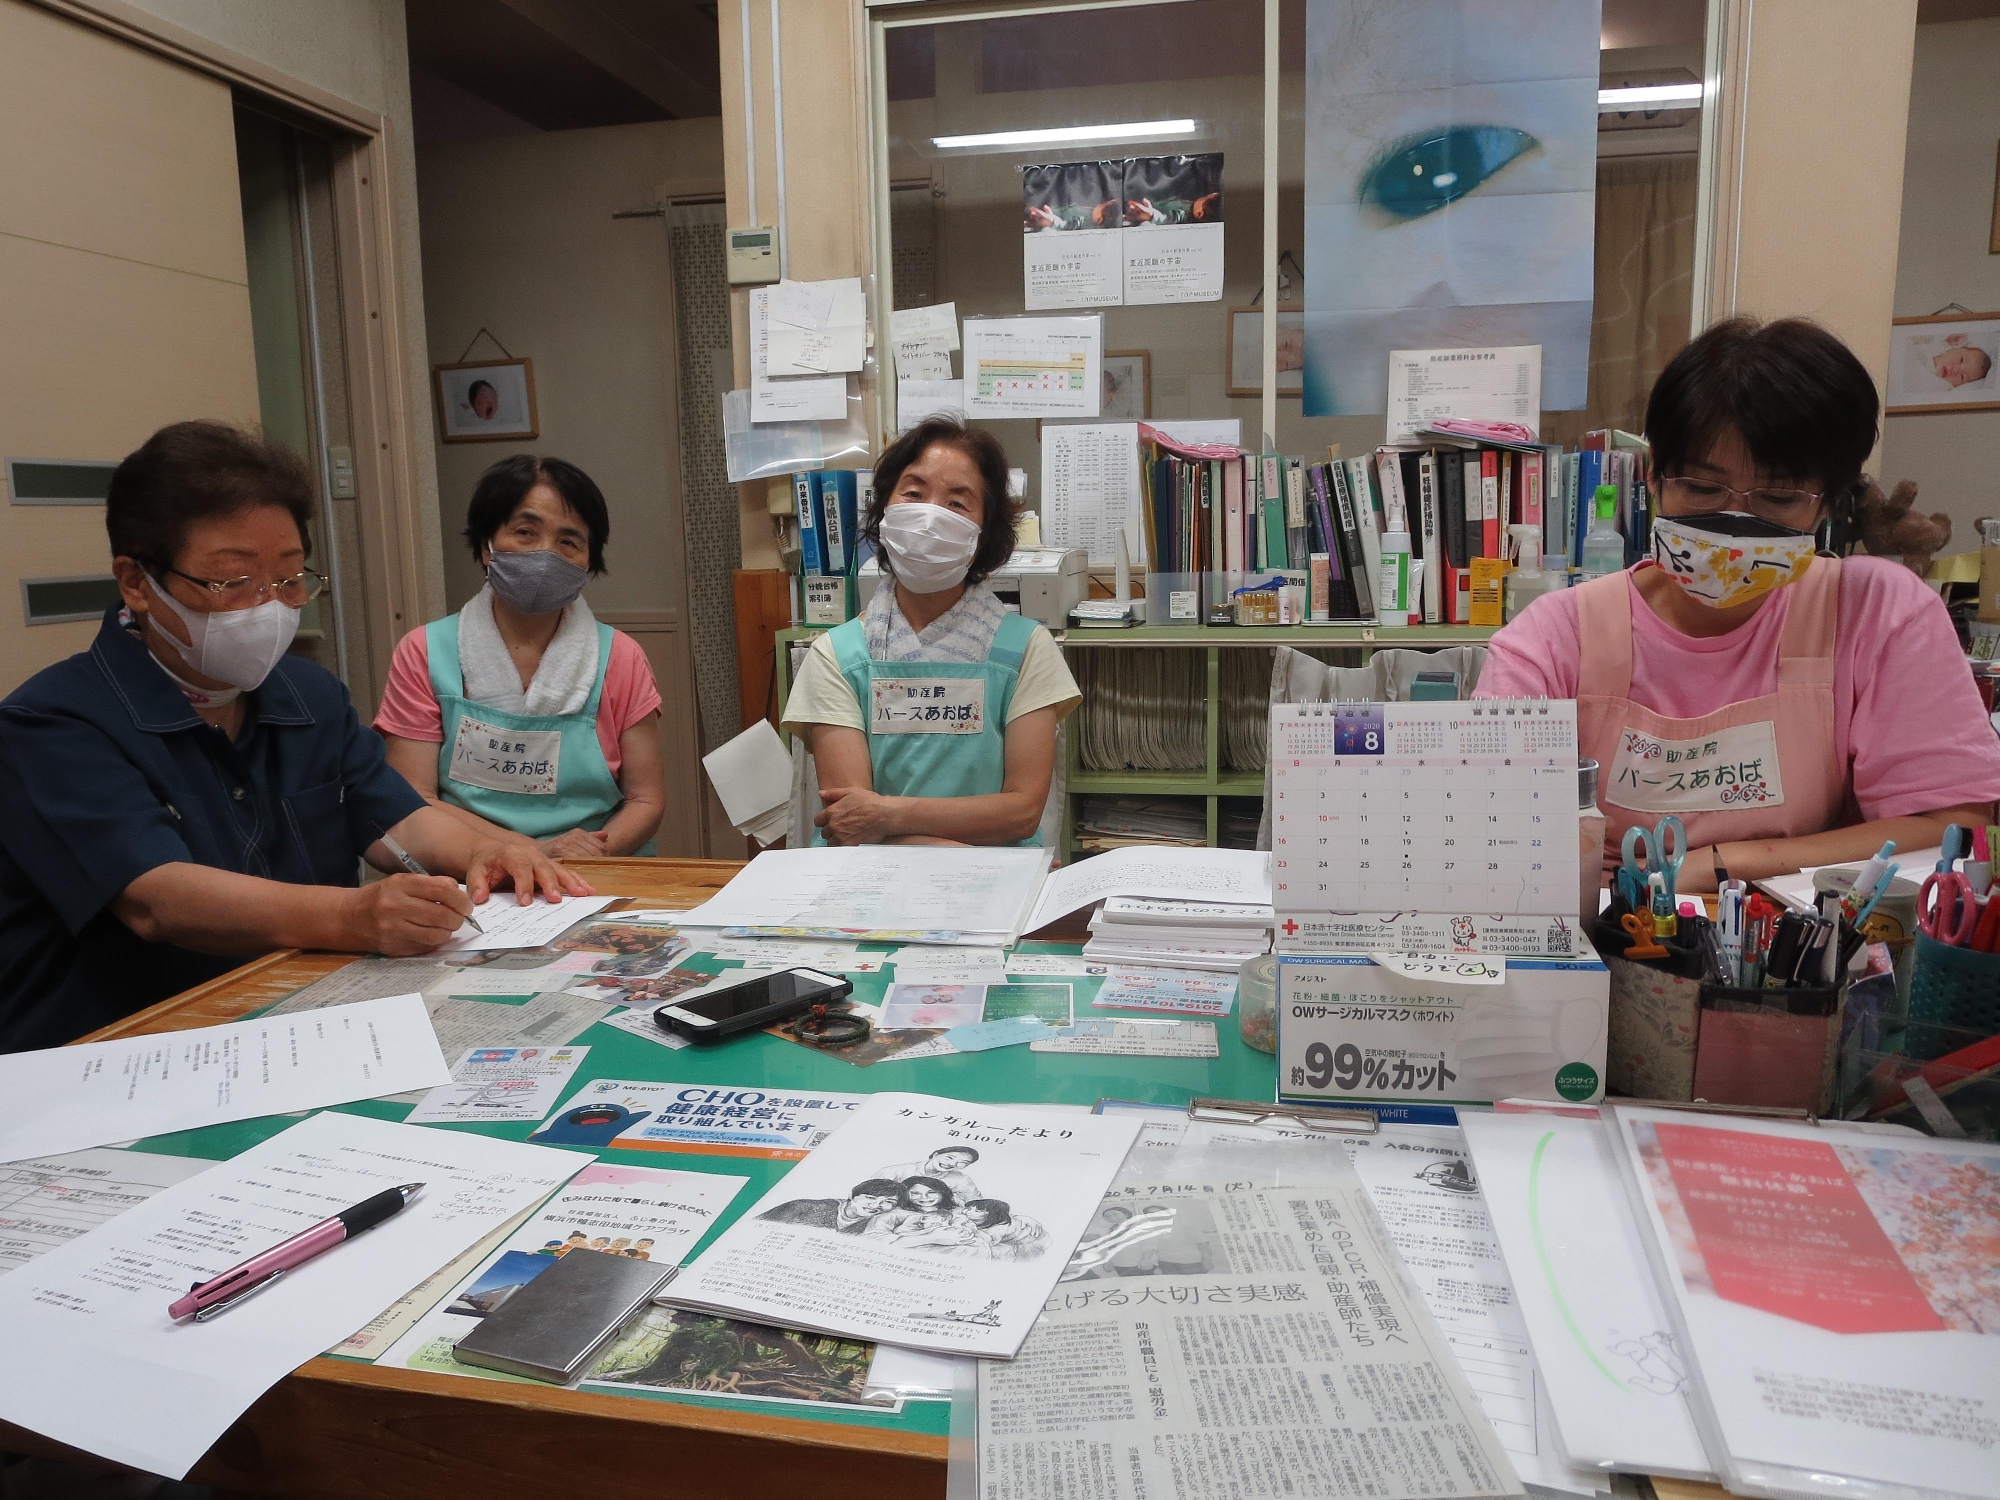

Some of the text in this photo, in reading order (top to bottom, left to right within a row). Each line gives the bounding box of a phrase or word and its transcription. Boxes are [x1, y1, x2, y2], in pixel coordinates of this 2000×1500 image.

[825, 495, 840, 545] 分娩台帳
[907, 686, 946, 698] 助産院
[878, 703, 973, 721] バースあおば
[1388, 722, 1394, 731] 9
[1449, 721, 1458, 730] 10
[1513, 721, 1521, 729] 11
[488, 739, 526, 754] 助産院
[1364, 731, 1379, 751] 8
[1666, 741, 1718, 764] 助産院
[458, 749, 550, 776] バースあおば
[1618, 758, 1763, 792] バースあおば
[1303, 923, 1394, 932] 日本赤十字社医療センター
[1404, 962, 1456, 972] どうぞ
[1292, 991, 1454, 1005] 花粉・細菌・ほこりをシャットアウト
[676, 1088, 860, 1111] CHOを設置して
[664, 1102, 797, 1121] 健康経営に
[1381, 1109, 1408, 1118] WHITE
[654, 1114, 816, 1133] 取り組んでいます
[895, 1107, 1074, 1140] カンガルーだより
[947, 1129, 1008, 1145] 第110号
[1277, 1130, 1468, 1158] カンガルの会 入会のお誘い
[1288, 1200, 1375, 1347] 署名集めた母親・助産師たち
[1315, 1199, 1409, 1344] 妊婦へのPCR・補償実現へ
[1042, 1283, 1308, 1312] 上げる大切さ実感
[1135, 1321, 1168, 1421] 助産所職員にも「慰労金」
